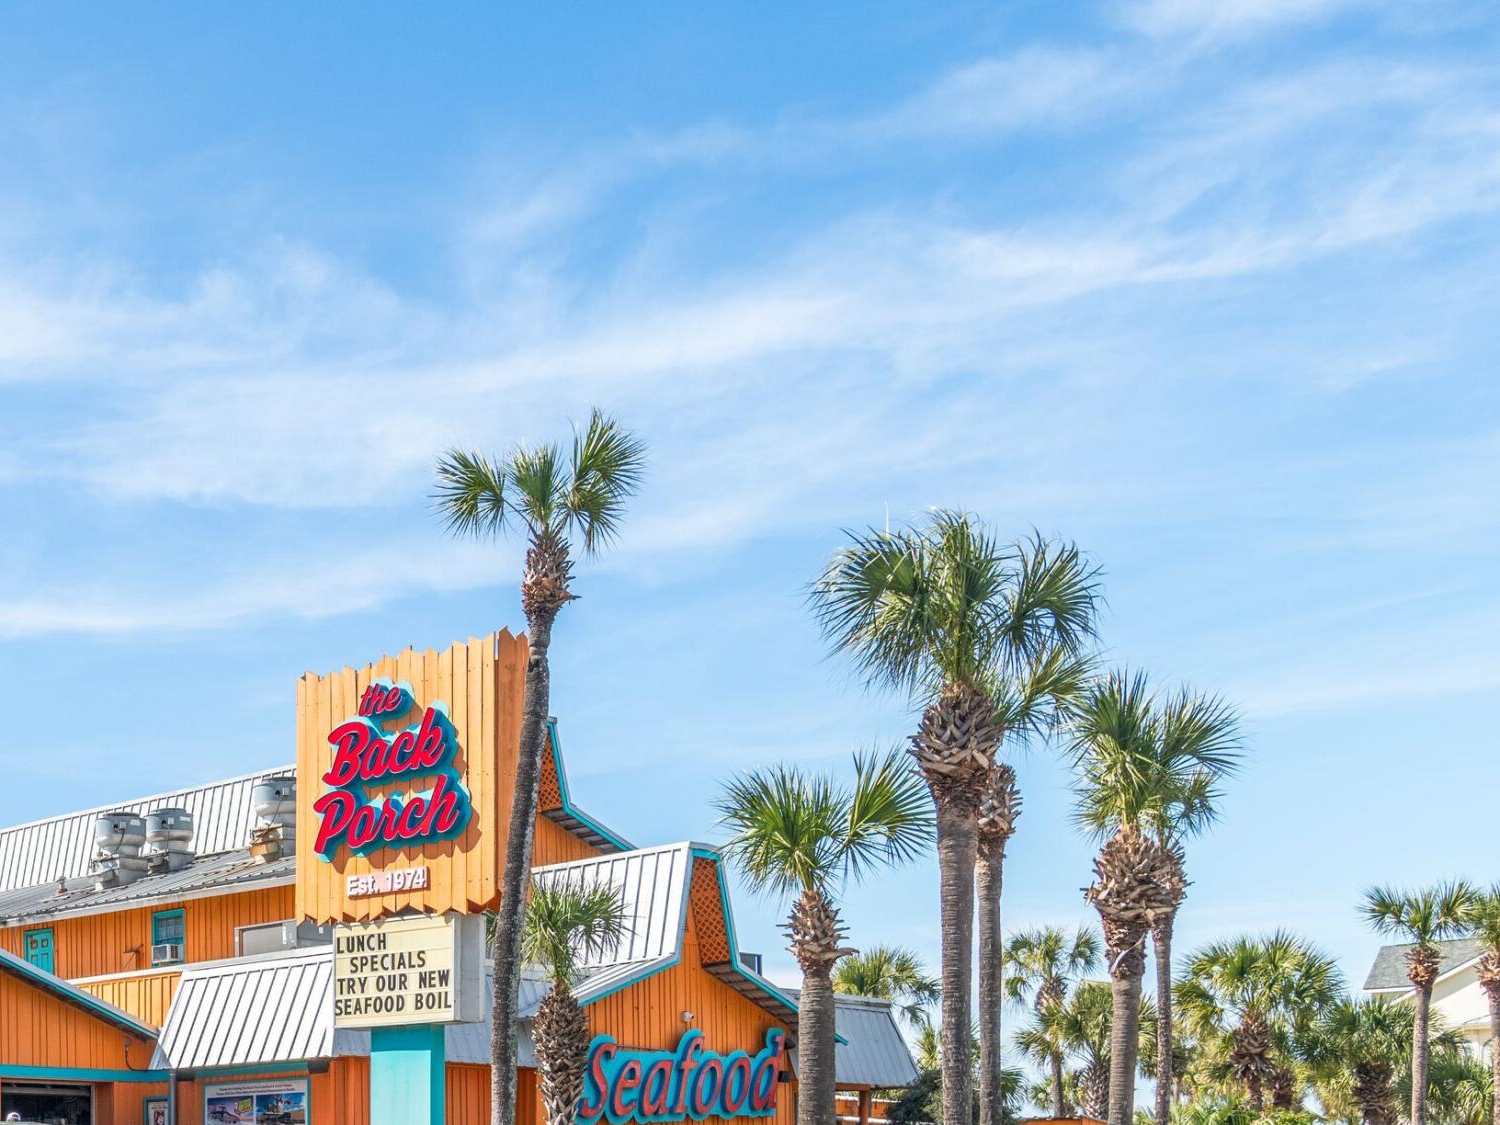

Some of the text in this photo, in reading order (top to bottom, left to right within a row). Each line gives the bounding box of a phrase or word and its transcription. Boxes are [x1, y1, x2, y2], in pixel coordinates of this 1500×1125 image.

[359, 682, 402, 717] the
[322, 706, 446, 787] Back
[313, 774, 459, 854] Porch
[347, 870, 427, 896] Est. 1974
[336, 932, 387, 955] LUNCH
[349, 950, 426, 974] SPECIALS
[337, 969, 450, 995] TRY OUR NEW
[335, 991, 452, 1016] SEAFOOD BOIL
[579, 1034, 785, 1119] Seafood
